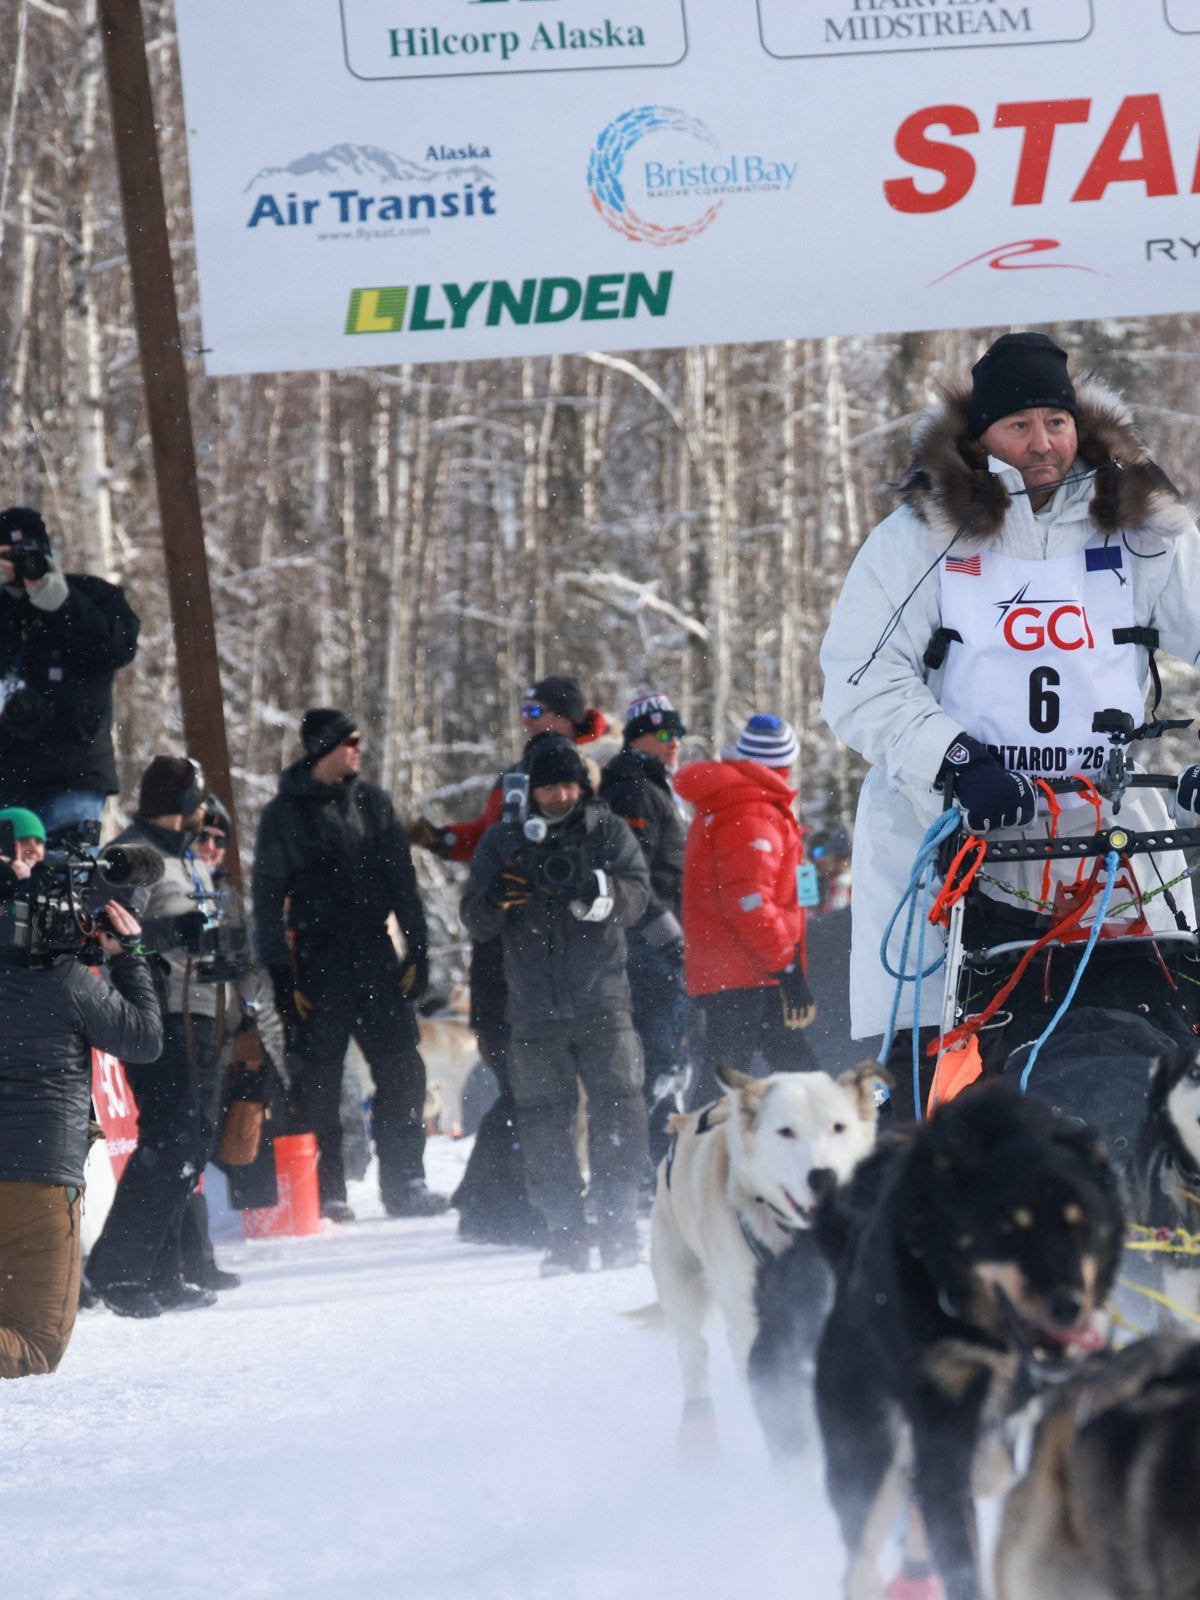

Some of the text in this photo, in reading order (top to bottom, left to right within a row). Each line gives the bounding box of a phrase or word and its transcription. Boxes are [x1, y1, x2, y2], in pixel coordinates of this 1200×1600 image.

[388, 19, 646, 59] Hilcorp Alaska
[824, 7, 1034, 43] MIDSTREAM
[425, 143, 491, 161] Alaska
[644, 154, 798, 189] Bristol Bay
[246, 183, 496, 227] Air Transit
[647, 183, 781, 198] NATIVE CORPORATION
[408, 270, 674, 331] LYNDEN
[1003, 605, 1095, 651] GCI
[1029, 665, 1060, 734] 6
